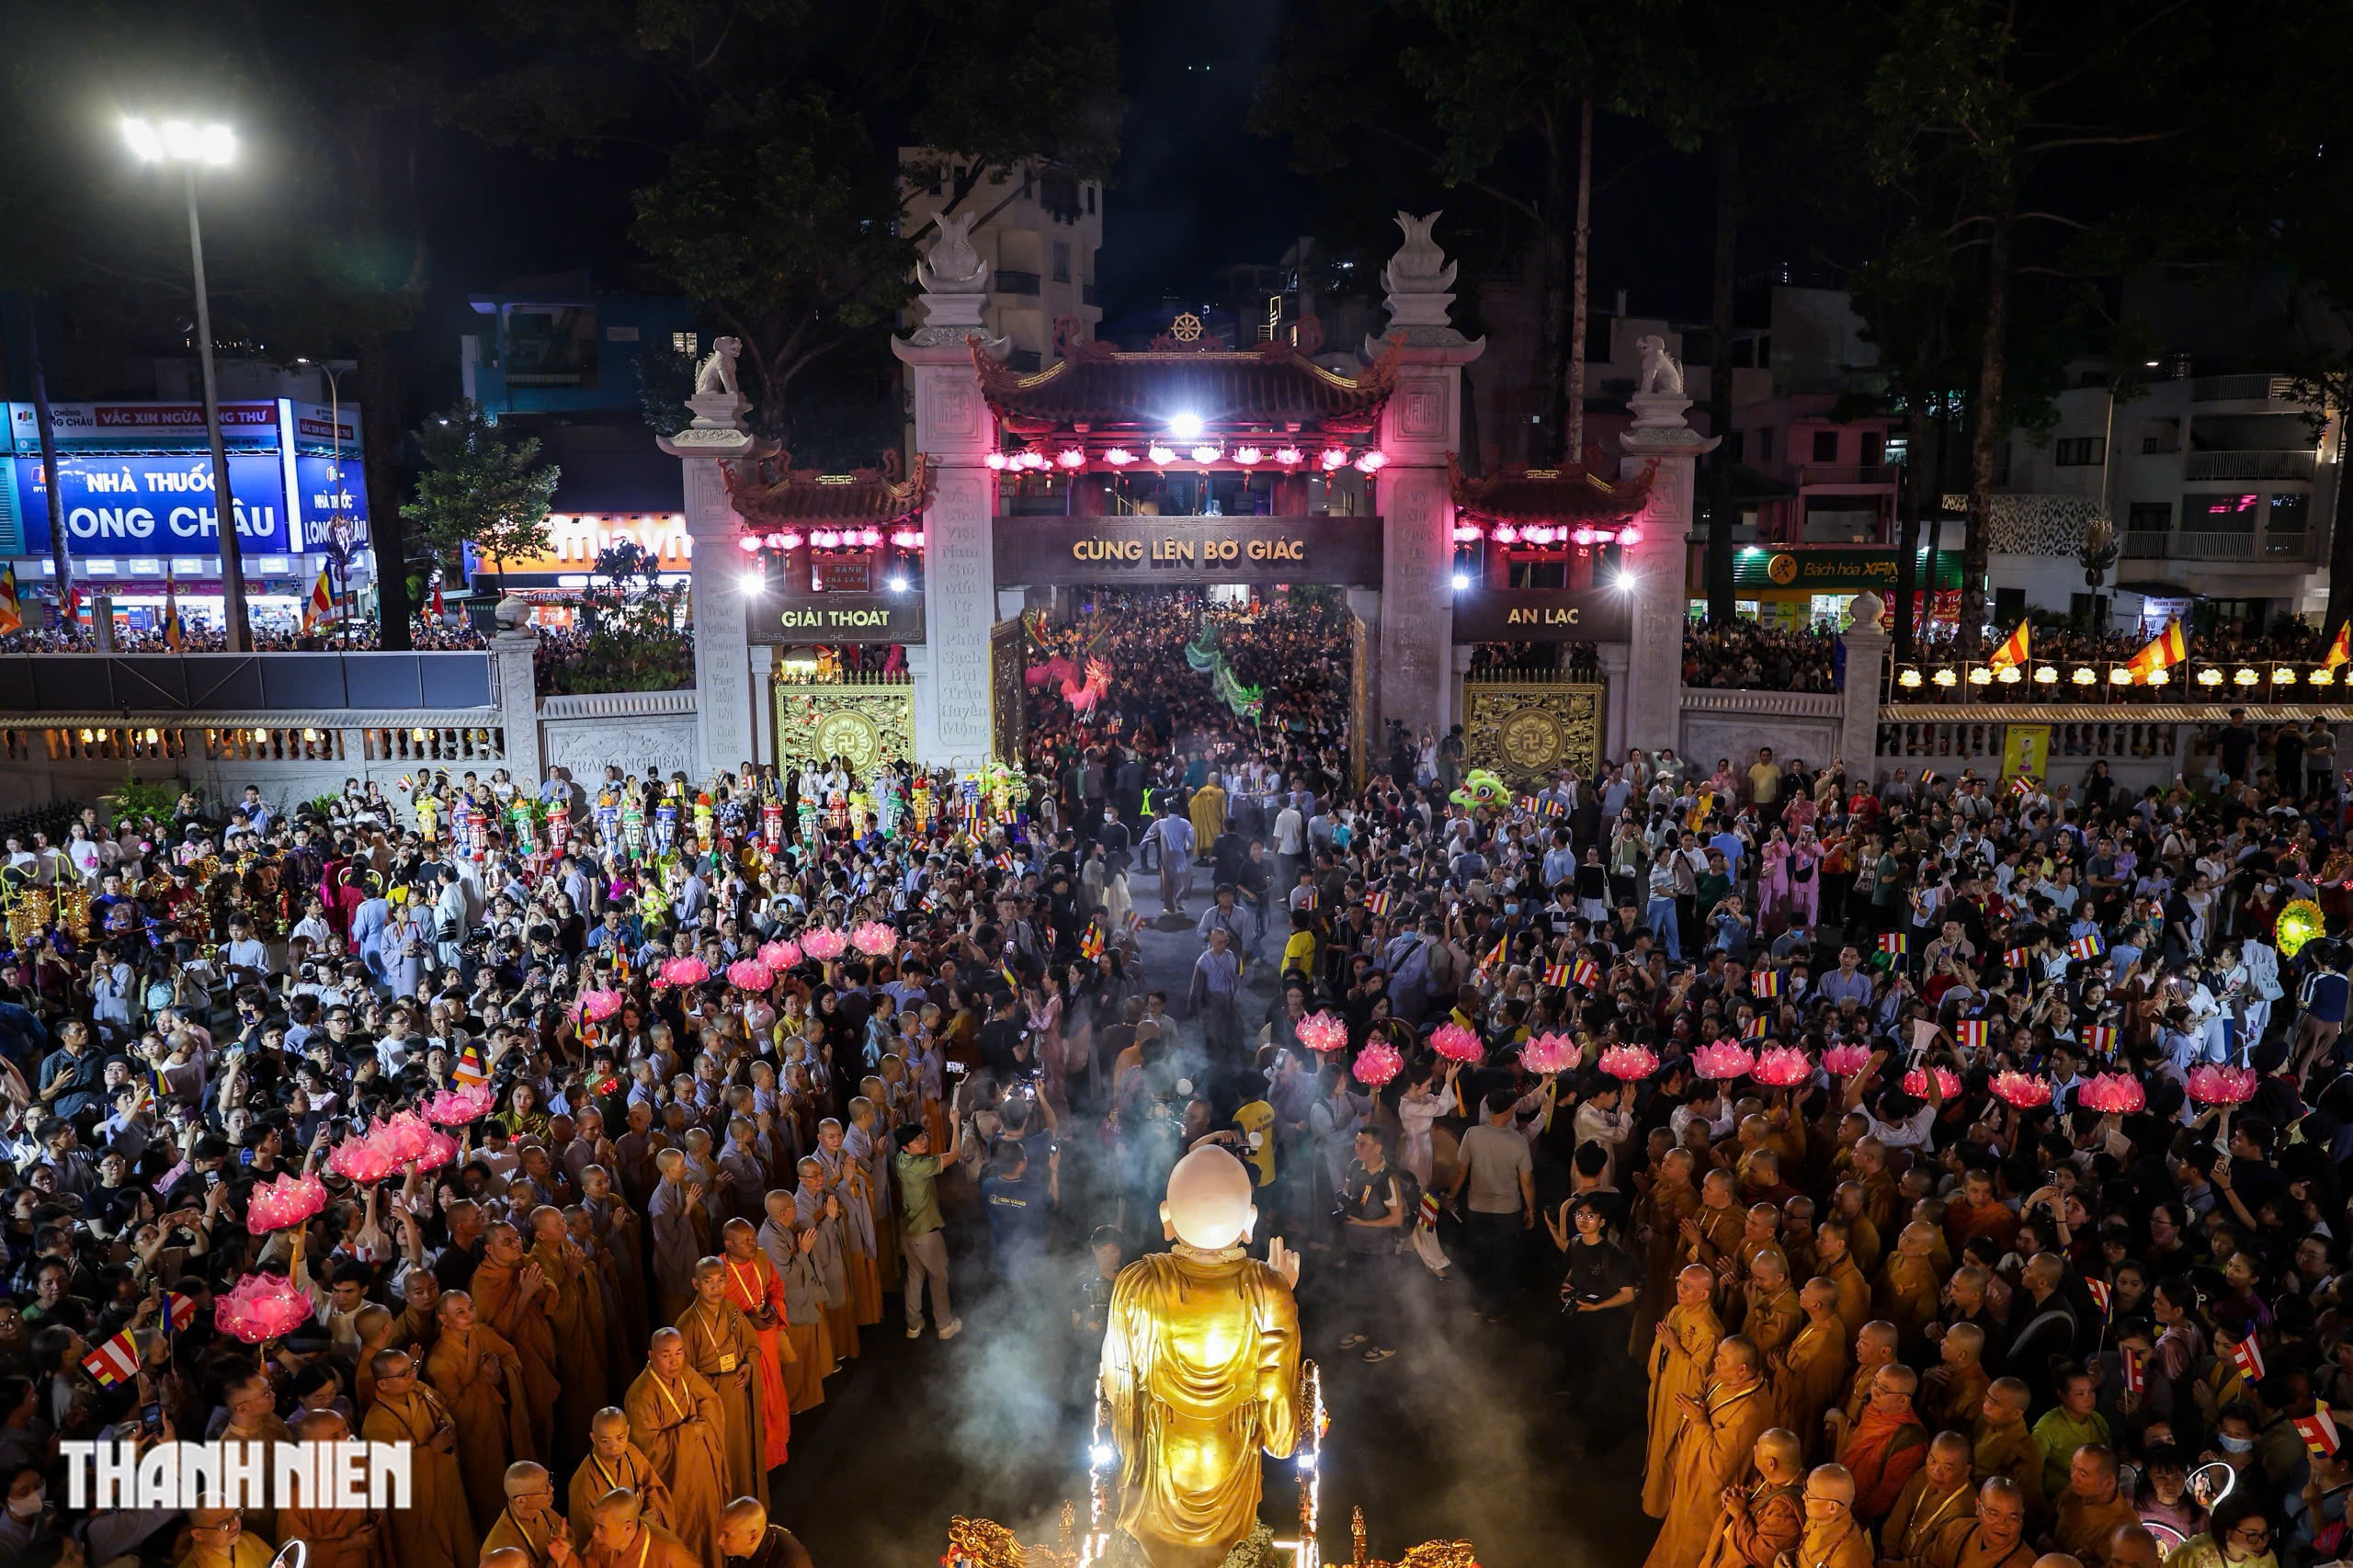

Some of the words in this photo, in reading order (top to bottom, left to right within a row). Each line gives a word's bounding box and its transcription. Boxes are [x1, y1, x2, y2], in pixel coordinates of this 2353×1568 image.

[102, 409, 132, 424] VẮC
[135, 413, 159, 424] XIN
[162, 410, 201, 423] NGỪA
[218, 412, 234, 422] NG
[237, 410, 267, 422] THƯ
[86, 465, 138, 492] NHÀ
[313, 489, 330, 509] NHÀ
[330, 488, 353, 509] THỐC
[64, 507, 155, 538] ONG
[169, 497, 275, 537] CHÂU
[1073, 535, 1143, 561] CÙNG
[1152, 536, 1195, 561] LÊN
[1204, 536, 1239, 561] BỜ
[1246, 536, 1303, 561] GIÁC
[1803, 562, 1836, 576] Bách
[1837, 562, 1860, 576] hóa
[1862, 562, 1898, 575] XAN
[781, 606, 823, 628] GIẢI
[828, 606, 891, 627] THOÁT
[1507, 608, 1538, 624] AN
[1545, 608, 1579, 628] LẠC
[624, 750, 686, 772] NGHIÊM
